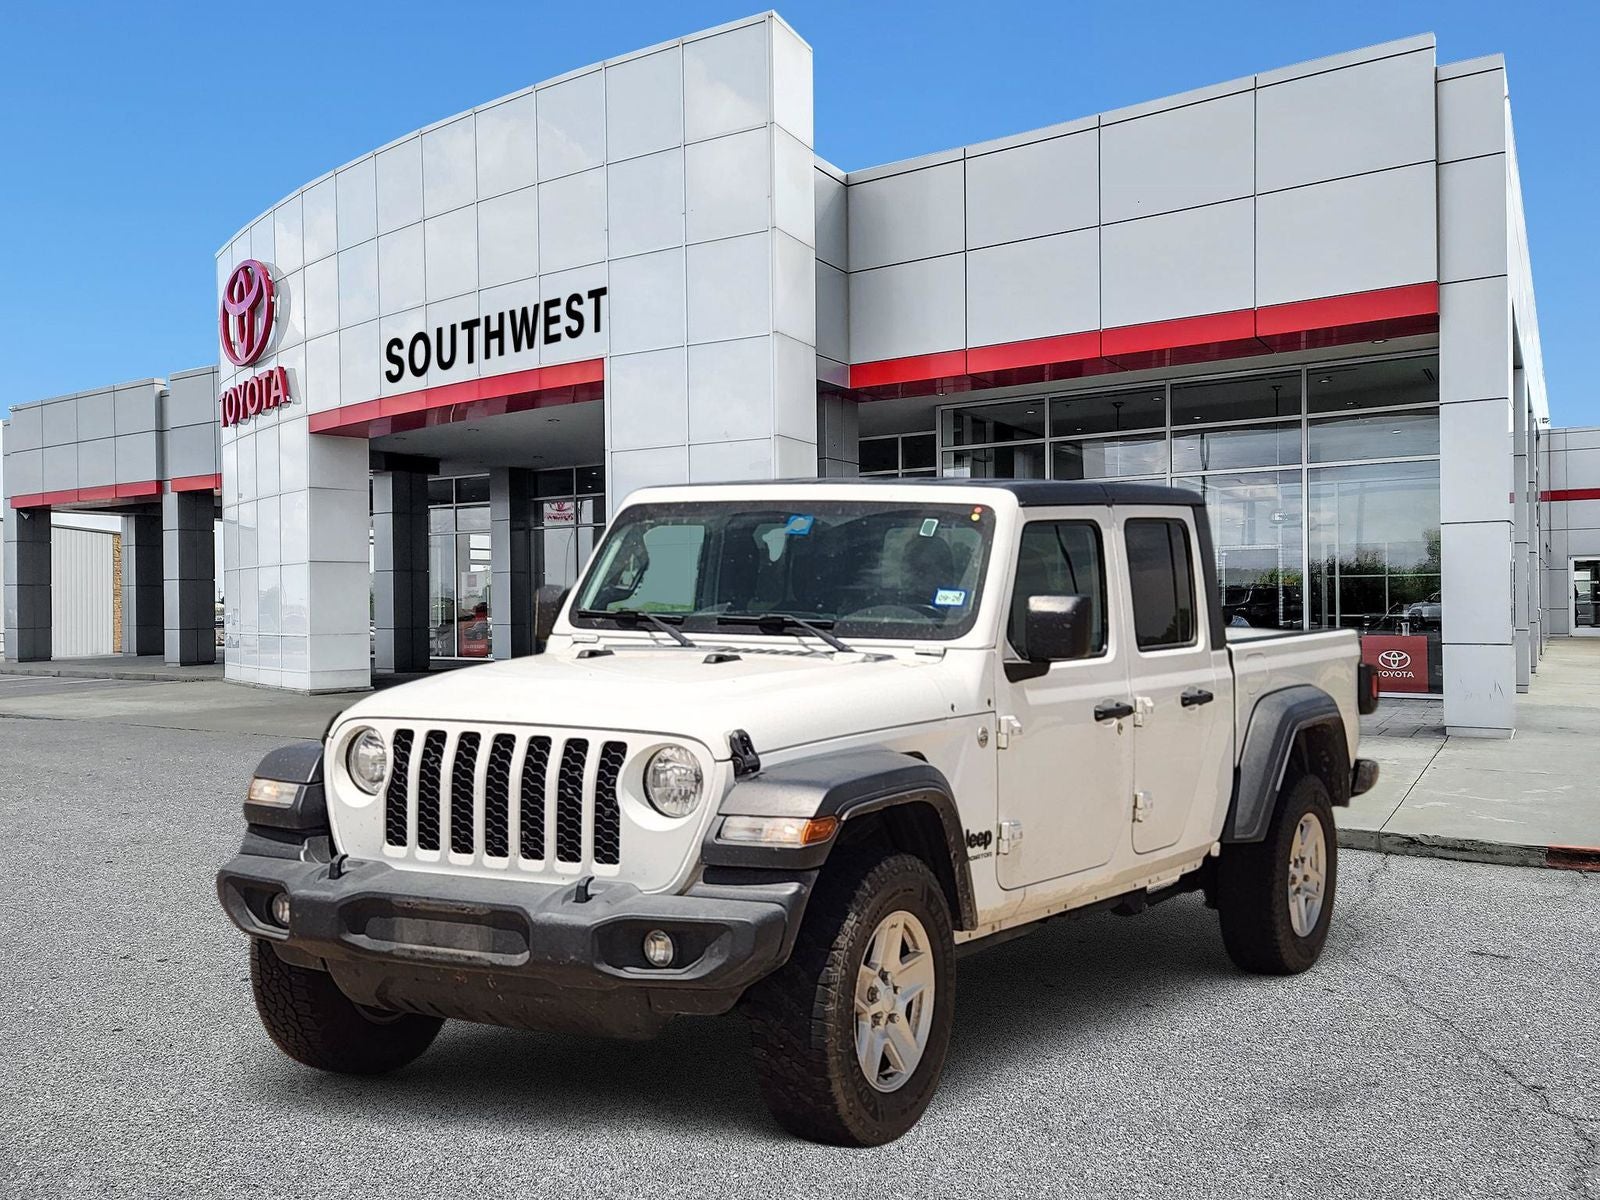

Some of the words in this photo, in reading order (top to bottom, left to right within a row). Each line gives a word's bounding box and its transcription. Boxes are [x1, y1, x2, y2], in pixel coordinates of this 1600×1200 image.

[385, 286, 608, 384] SOUTHWEST
[218, 366, 289, 428] TOYOTA
[1377, 670, 1415, 678] TOYOTA
